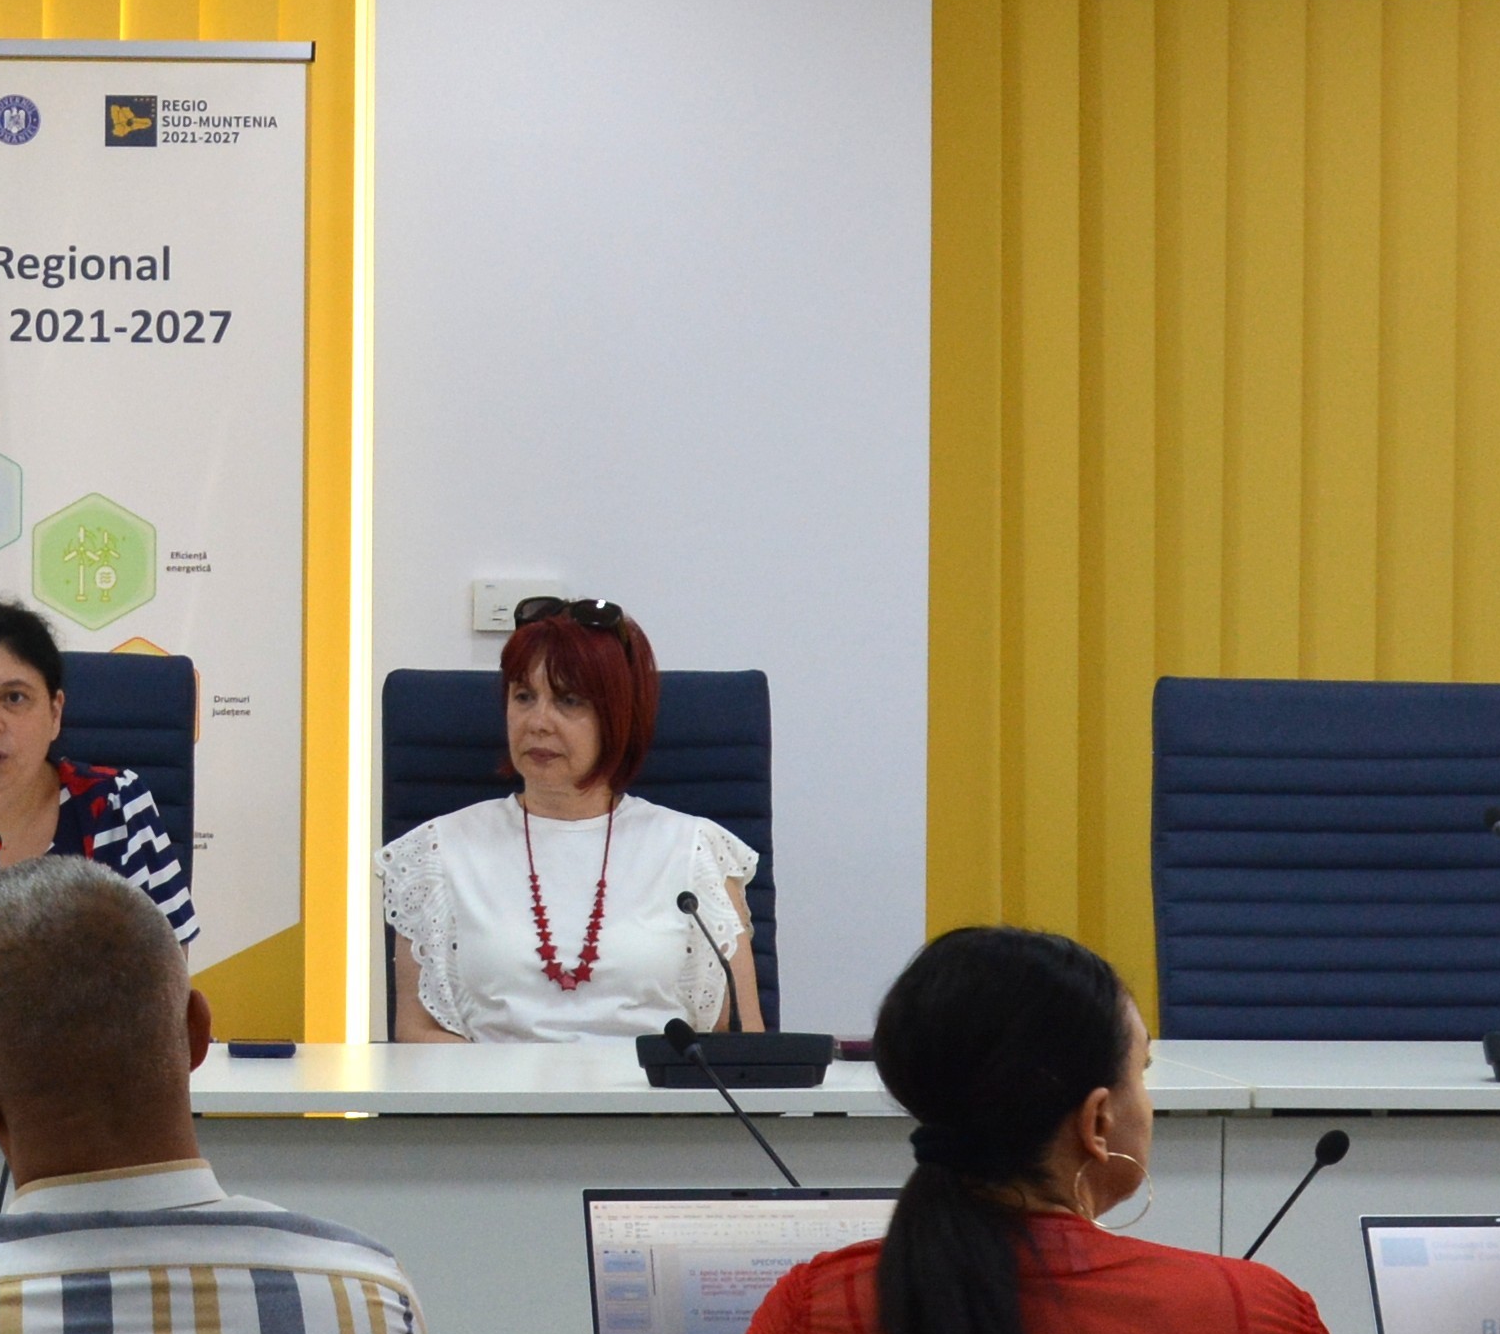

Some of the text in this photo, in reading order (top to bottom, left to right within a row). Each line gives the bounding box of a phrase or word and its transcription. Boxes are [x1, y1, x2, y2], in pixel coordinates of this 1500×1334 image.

[162, 100, 207, 112] REGIO
[162, 116, 277, 128] SUD-MUNTENIA
[162, 131, 239, 143] 2021-2027
[10, 309, 231, 343] 2021-2027
[213, 695, 250, 704] Drumuri
